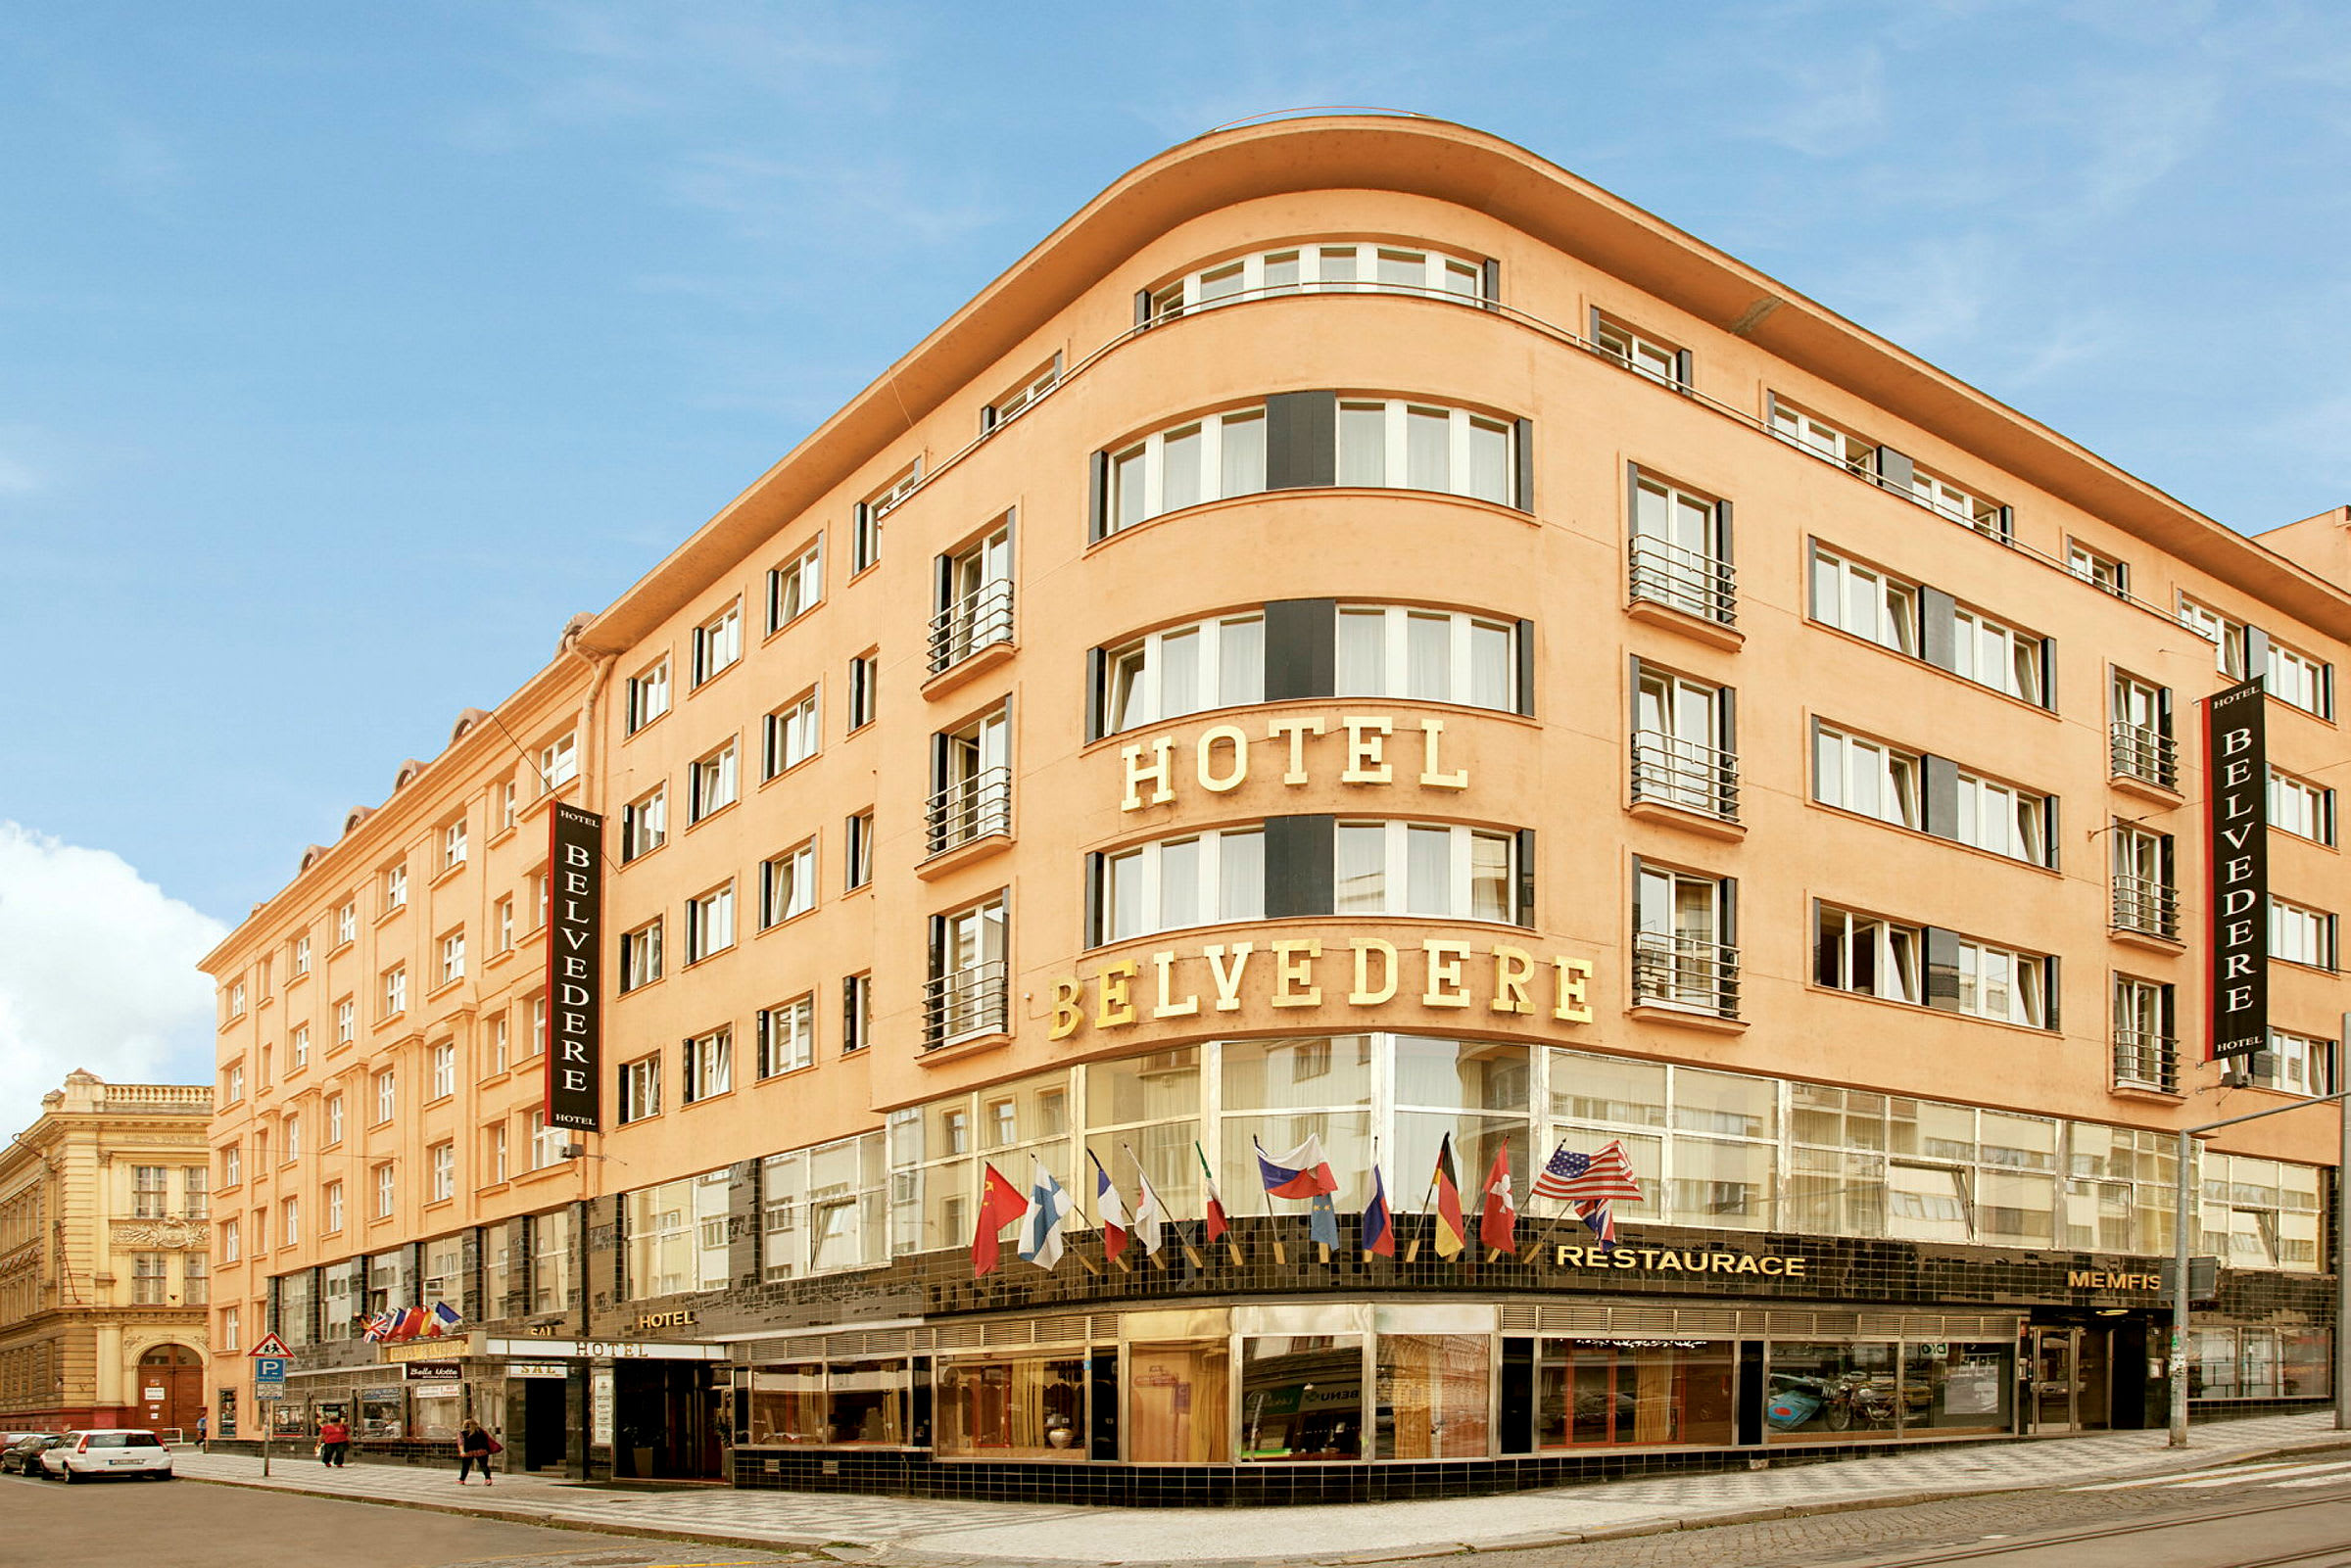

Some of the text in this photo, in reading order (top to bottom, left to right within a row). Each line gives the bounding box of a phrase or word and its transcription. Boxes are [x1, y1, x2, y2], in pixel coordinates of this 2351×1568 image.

[2214, 687, 2261, 709] HOTEL
[1121, 716, 1469, 813] HOTEL
[560, 809, 600, 829] HOTEL
[2221, 728, 2257, 1014] BELVEDERE
[560, 842, 590, 1092] BELVEDERE
[1048, 937, 1593, 1041] BELVEDERE
[2217, 1036, 2263, 1053] HOTEL
[555, 1113, 597, 1126] HOTEL
[1557, 1245, 1806, 1277] RESTAURACE
[2068, 1271, 2162, 1291] MEMFIS
[640, 1310, 695, 1329] HOTEL
[575, 1342, 649, 1357] HOTEL
[262, 1360, 279, 1375] P
